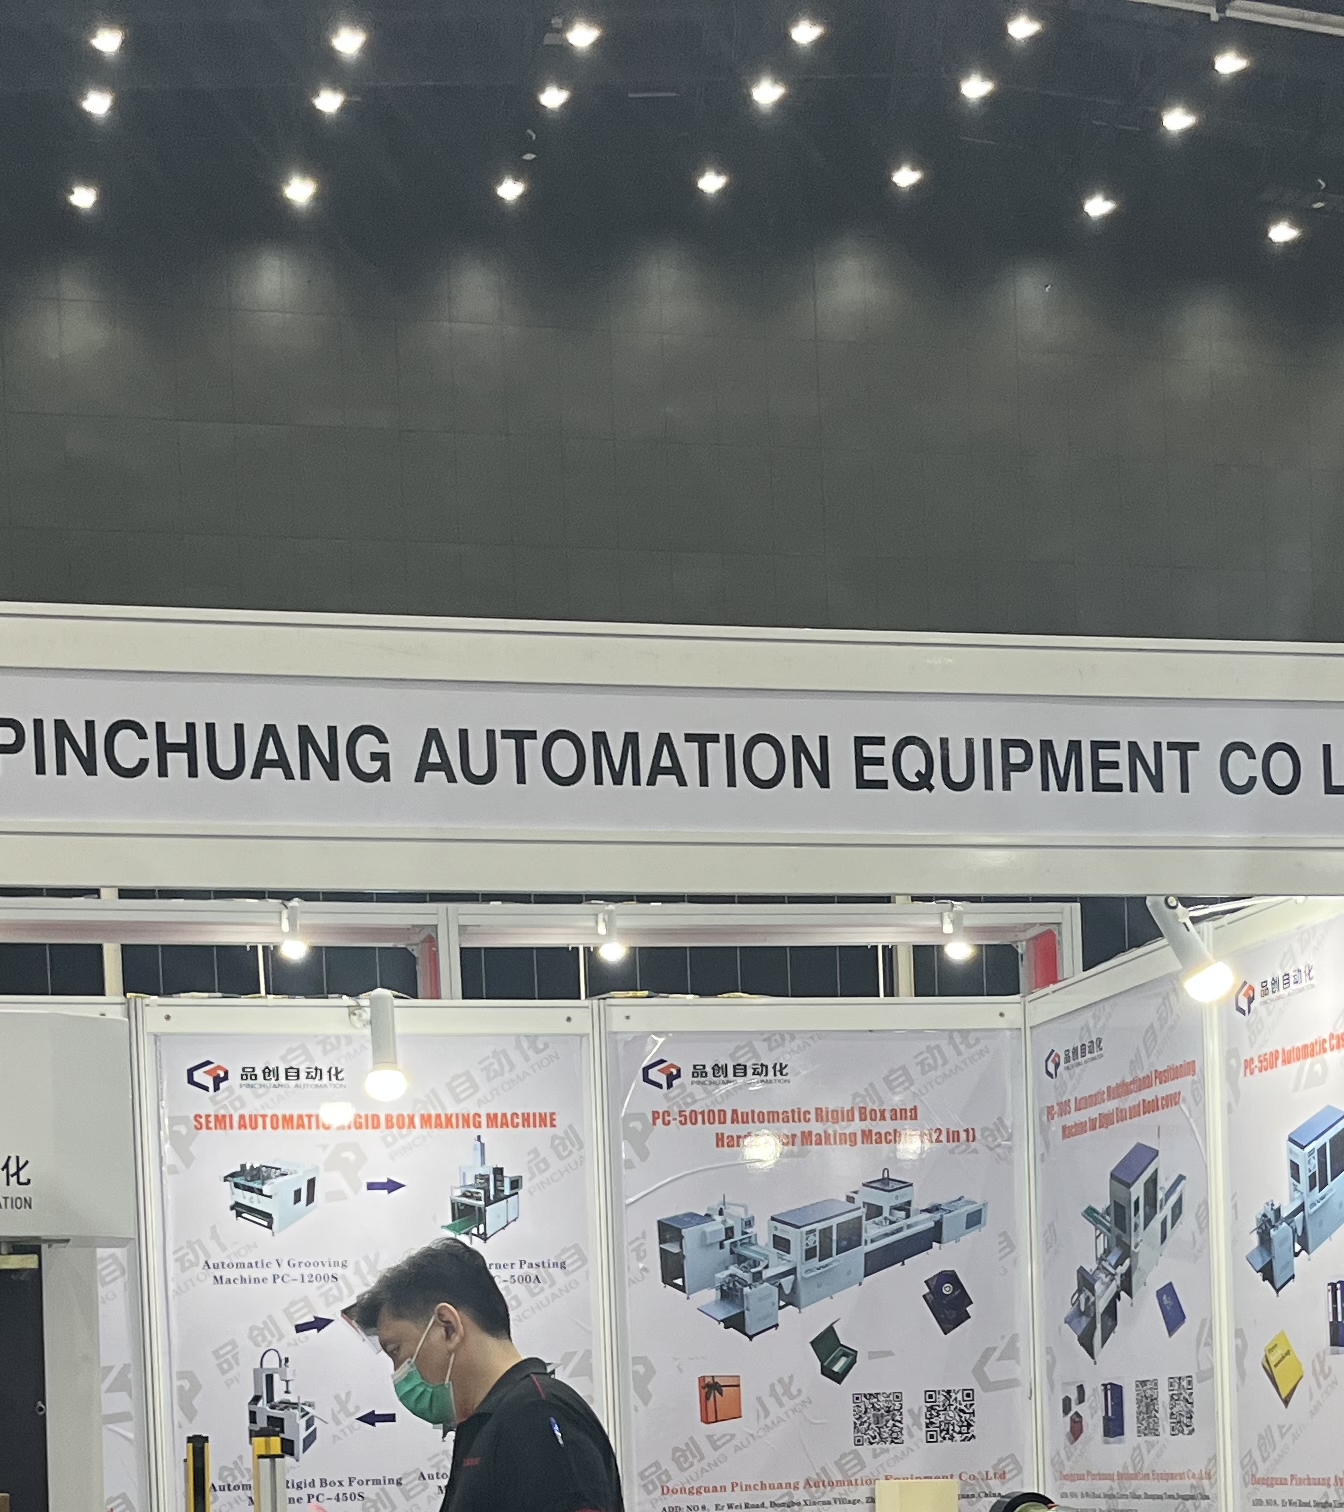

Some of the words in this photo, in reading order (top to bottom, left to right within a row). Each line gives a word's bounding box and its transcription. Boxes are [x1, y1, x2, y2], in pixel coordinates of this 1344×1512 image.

[414, 726, 829, 791] AUTOMATION
[854, 734, 1199, 797] EQUIPMENT
[1218, 741, 1298, 797] CO
[1260, 963, 1313, 998] 品创自动化
[1244, 1049, 1280, 1077] PC-550P
[1281, 1036, 1327, 1066] Automatic
[240, 1065, 345, 1083] 品创自动化
[691, 1062, 789, 1079] 品创自动化
[193, 1114, 234, 1132] SEMI
[385, 1113, 416, 1130] BOX
[419, 1112, 482, 1129] MAKING
[486, 1112, 557, 1129] MACHINE
[652, 1108, 727, 1127] PC-5010D
[731, 1106, 811, 1125] Automatic
[815, 1105, 854, 1126] Rigid
[858, 1106, 887, 1123] Box
[889, 1105, 918, 1122] and
[800, 1129, 857, 1148] Making
[203, 1259, 272, 1270] Automatic
[276, 1259, 284, 1269] V
[287, 1258, 348, 1269] Grooving
[488, 1261, 516, 1270] rner
[519, 1259, 566, 1271] Pasting
[213, 1275, 269, 1285] Machine
[272, 1273, 339, 1285] PC-1200S
[319, 1478, 344, 1488] Box
[348, 1476, 403, 1487] Forming
[661, 1485, 727, 1496] Dongguan
[731, 1481, 800, 1492] Pinchuang
[307, 1492, 365, 1503] PC-450S
